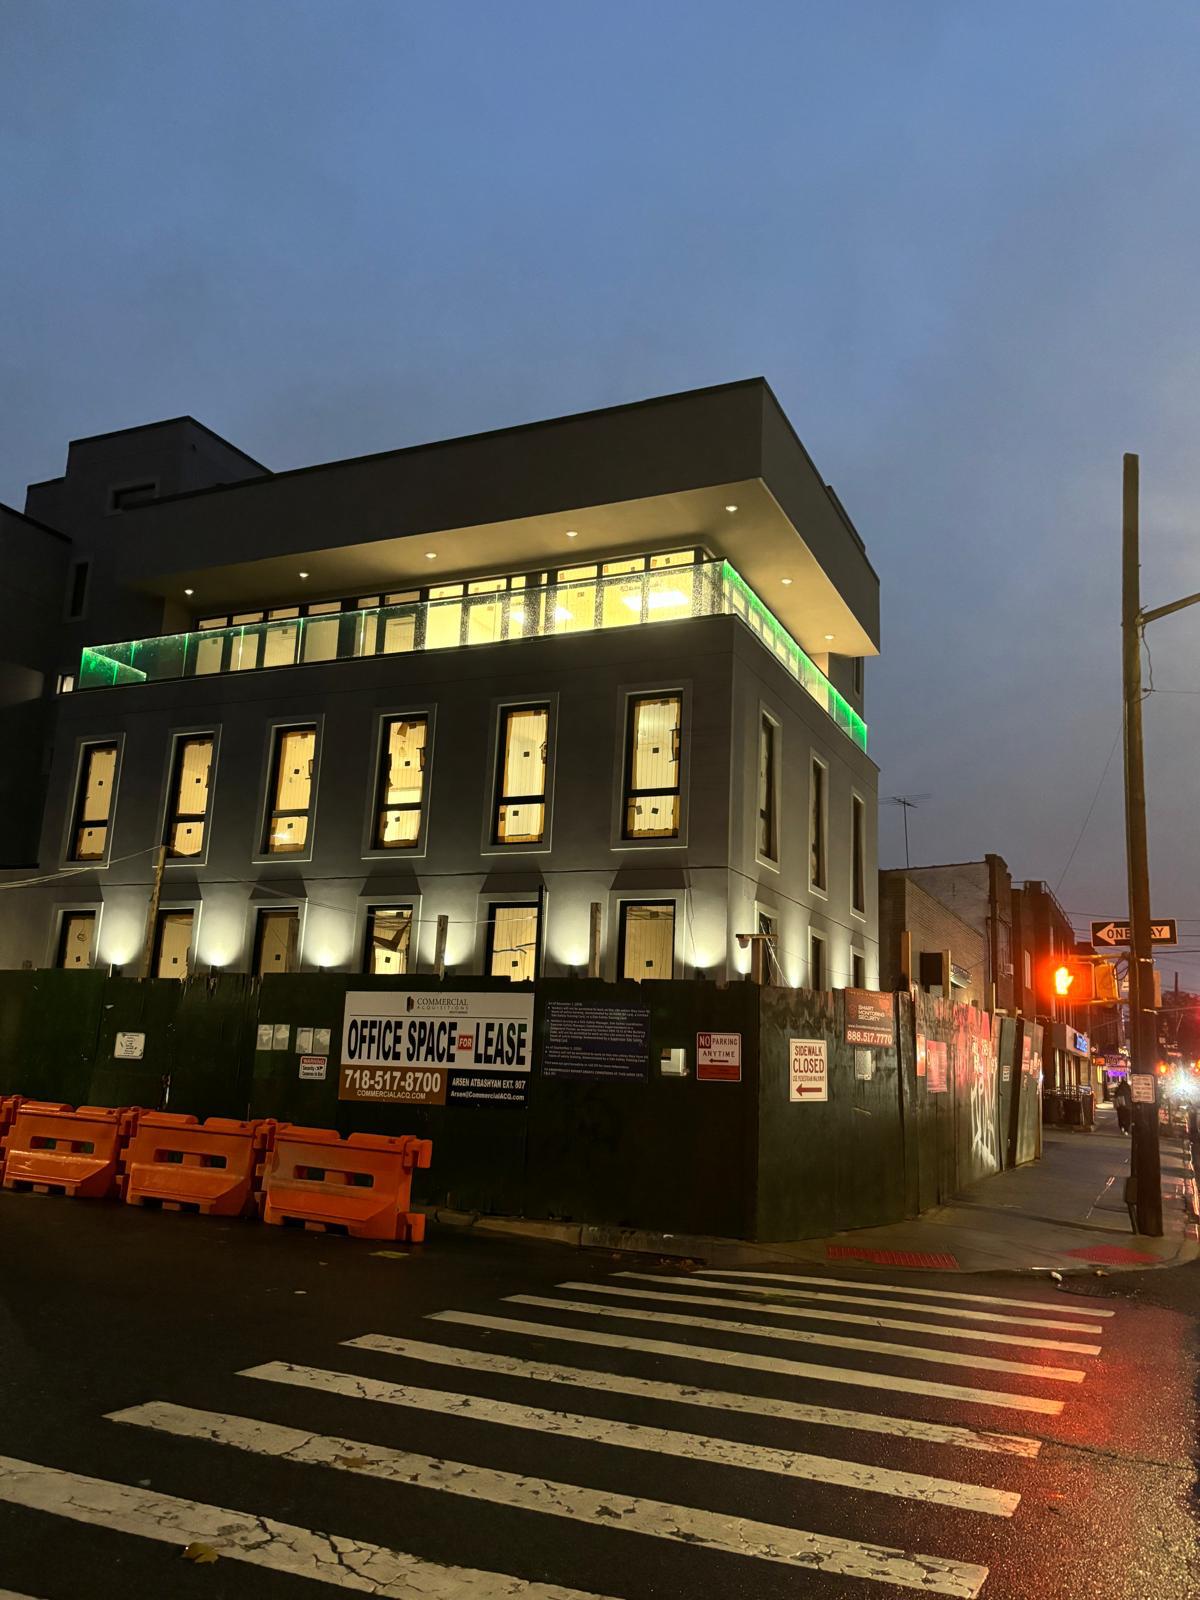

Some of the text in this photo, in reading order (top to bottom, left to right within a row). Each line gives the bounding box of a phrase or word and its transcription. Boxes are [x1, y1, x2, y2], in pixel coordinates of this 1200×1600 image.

[1107, 928, 1130, 939] ONE
[416, 998, 469, 1006] COMMERCIAL
[348, 1019, 403, 1061] OFFICE
[406, 1020, 458, 1063] SPACE
[458, 1037, 473, 1048] FOR
[474, 1022, 528, 1066] LEASE
[699, 1035, 711, 1047] NO
[847, 1030, 892, 1045] 888.517.7770
[794, 1045, 822, 1056] SIDEWALK
[793, 1058, 825, 1073] CLOSED
[344, 1069, 441, 1093] 718-517-8700
[451, 1077, 470, 1087] ARSEN
[356, 1089, 427, 1100] COMMERCIALACQ.COM
